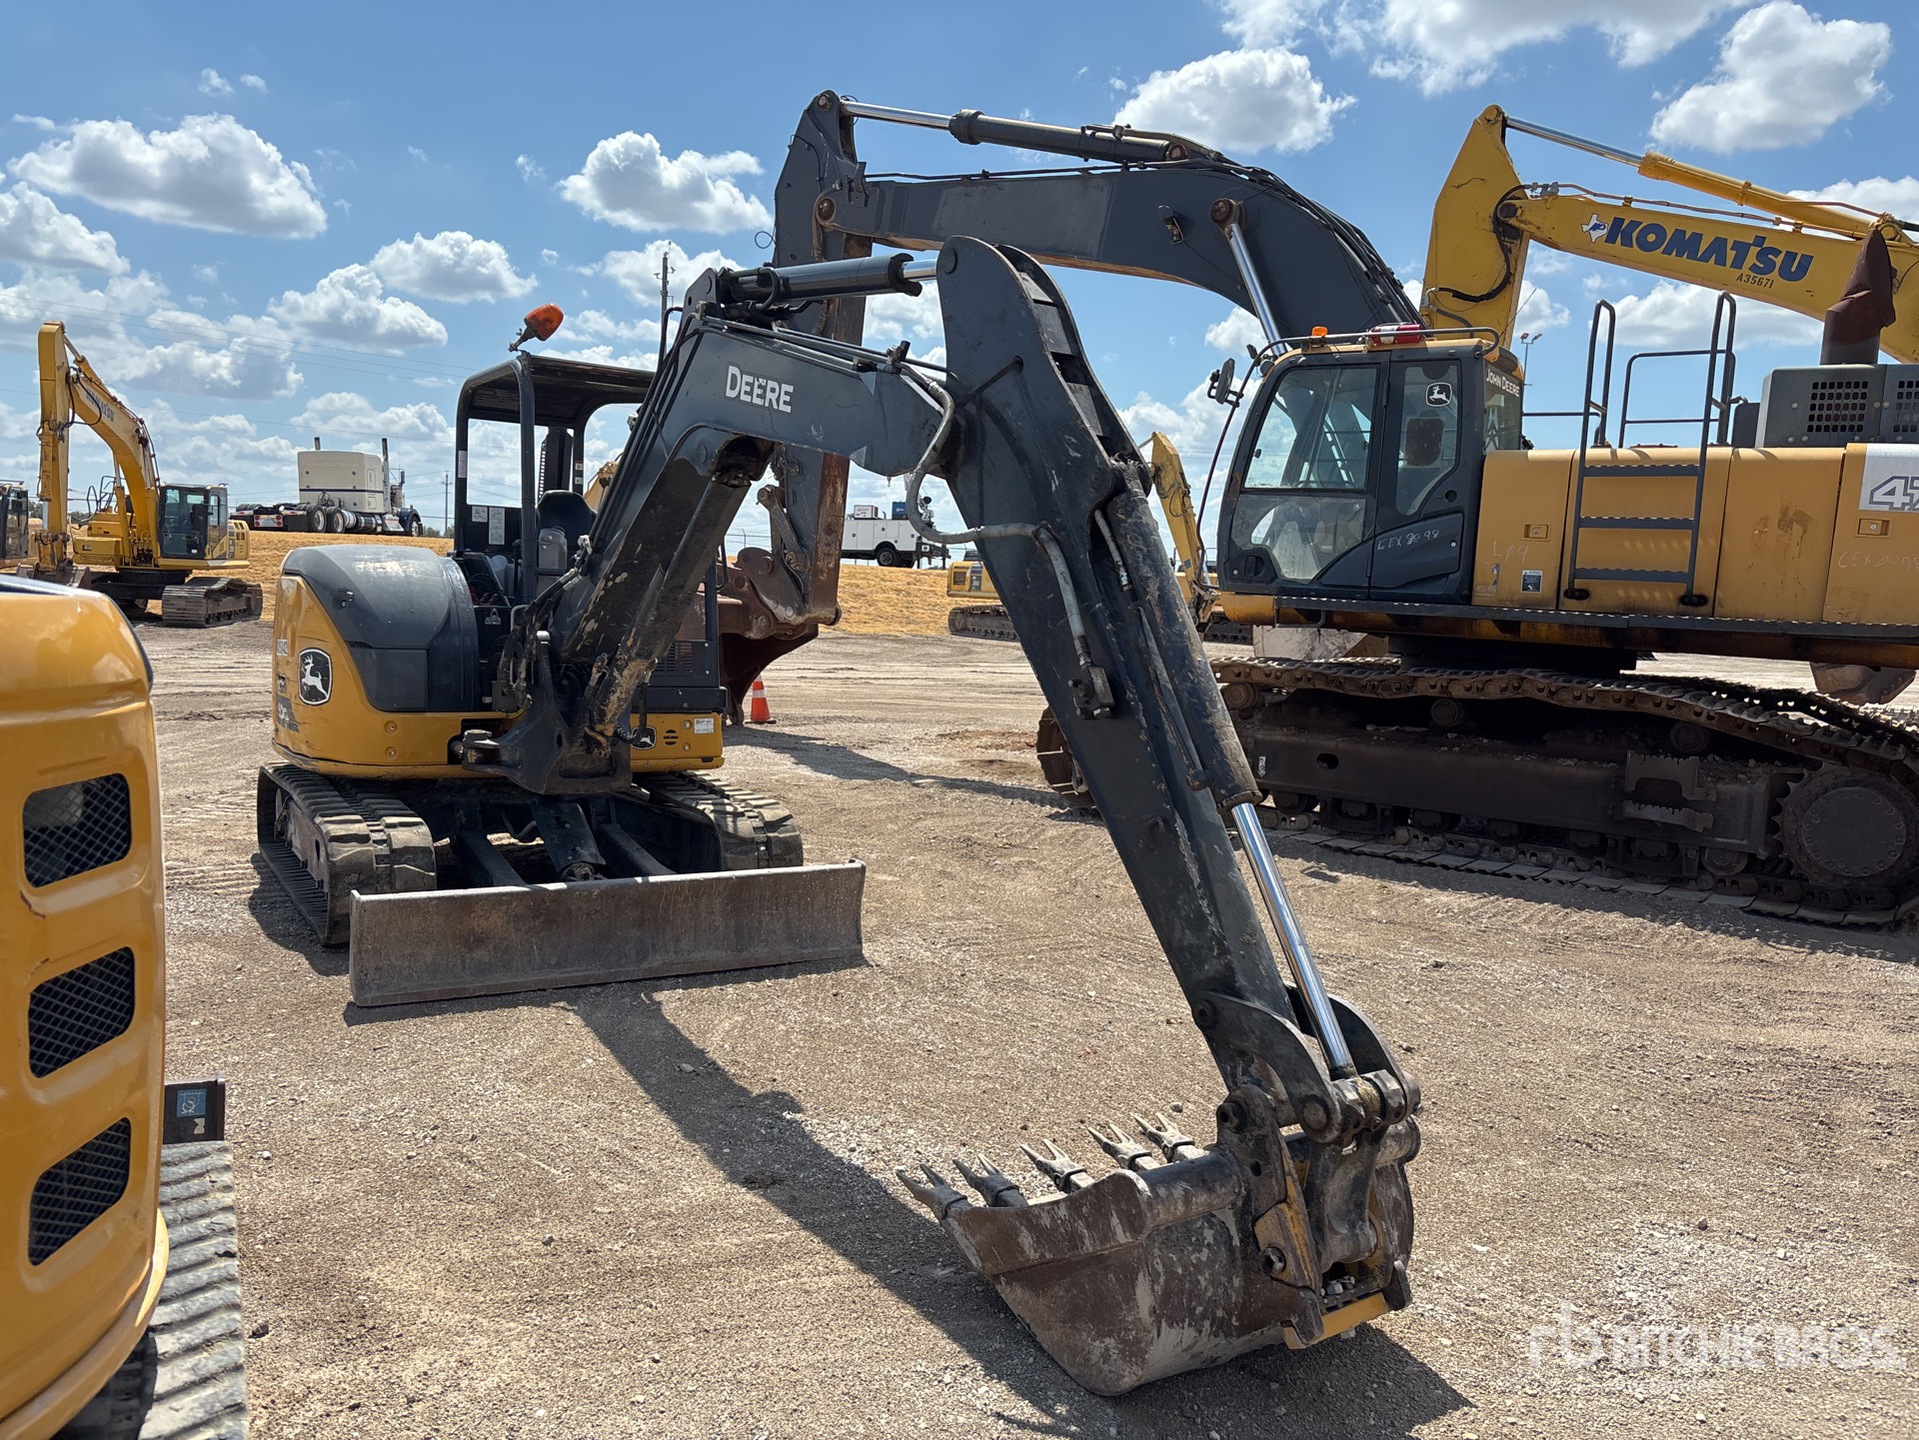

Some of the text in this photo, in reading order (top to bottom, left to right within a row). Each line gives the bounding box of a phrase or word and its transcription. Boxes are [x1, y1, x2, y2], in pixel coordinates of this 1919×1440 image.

[1604, 217, 1814, 282] KOMATSU
[1736, 273, 1775, 289] A35671
[725, 365, 794, 413] DEERE
[1486, 368, 1520, 398] JOHN DEERE
